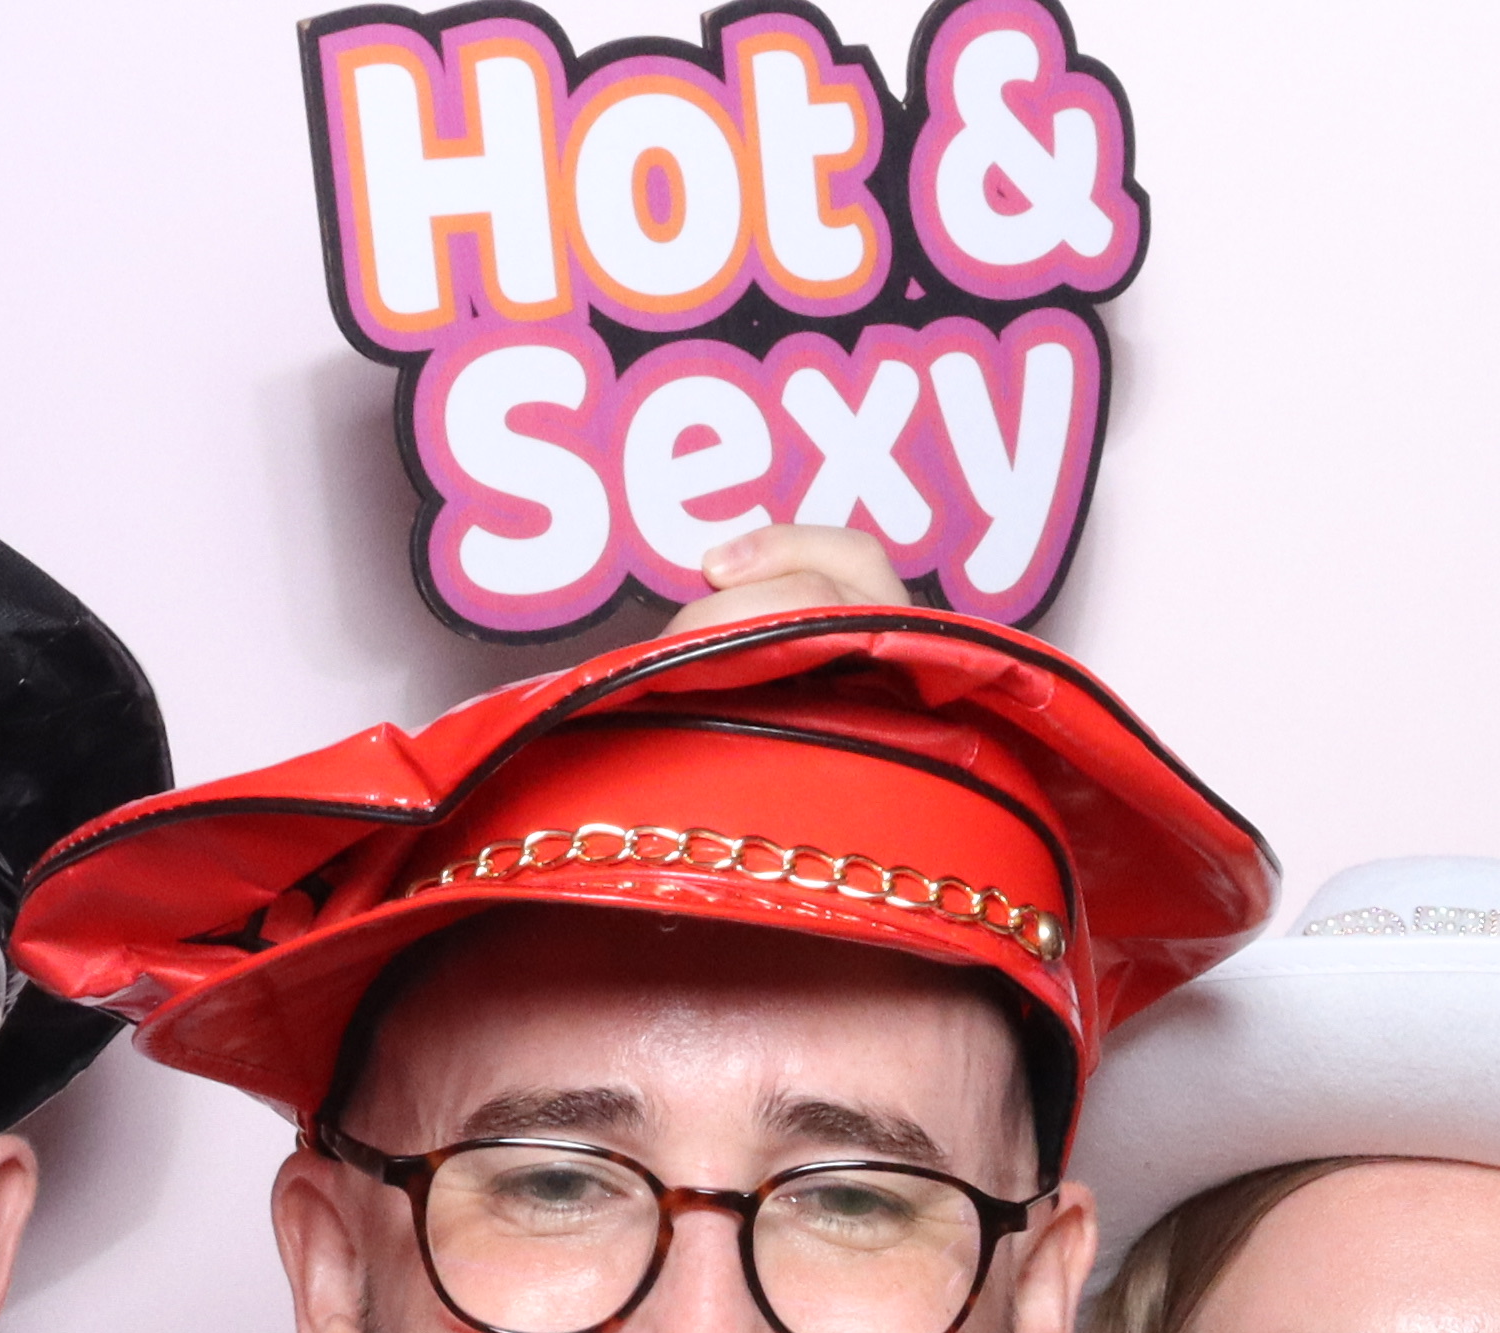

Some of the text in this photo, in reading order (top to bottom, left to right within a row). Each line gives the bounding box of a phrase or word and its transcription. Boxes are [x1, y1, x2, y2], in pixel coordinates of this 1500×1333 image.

[350, 28, 1115, 318] Hot &
[443, 341, 1076, 597] Sexy
